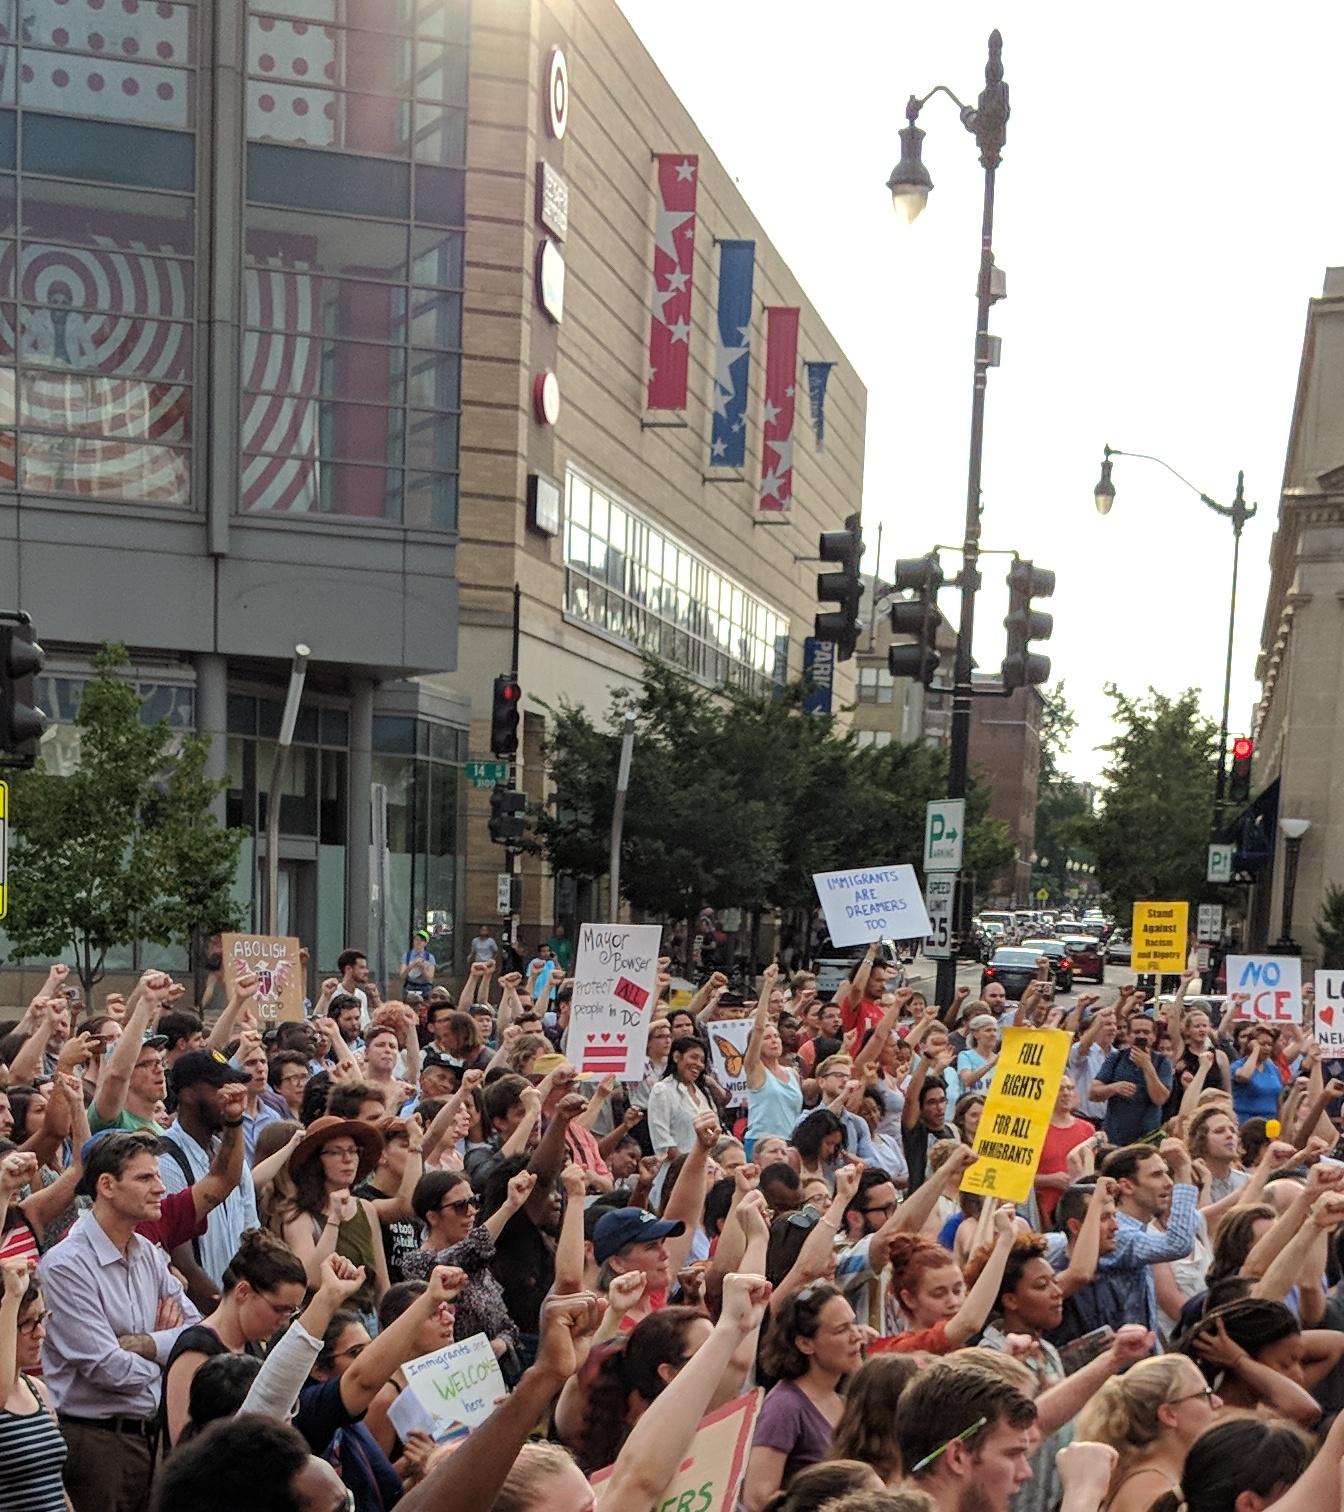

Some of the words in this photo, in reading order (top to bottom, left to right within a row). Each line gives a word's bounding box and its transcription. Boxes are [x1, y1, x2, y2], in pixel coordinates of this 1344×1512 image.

[473, 764, 485, 777] 14
[827, 871, 898, 890] IMMIGRANTS
[929, 881, 951, 895] SPEED
[855, 888, 878, 903] ARE
[846, 899, 907, 919] DREAMERS
[1147, 909, 1174, 918] Stand
[864, 918, 887, 931] TOO
[925, 917, 948, 948] 25
[1142, 923, 1177, 935] Against
[234, 940, 287, 958] ABOLISH
[584, 928, 630, 964] Mayor
[1145, 938, 1173, 947] Racism
[612, 952, 652, 973] Bowser
[1239, 961, 1280, 987] NO
[258, 1003, 277, 1018] ICE
[574, 1004, 604, 1023] people
[608, 1004, 617, 1017] in
[621, 1009, 641, 1027] DC
[1231, 991, 1292, 1021] ICE
[1017, 1042, 1045, 1067] FULL
[1001, 1073, 1044, 1101] RIGHTS
[992, 1113, 1012, 1136] FOR
[1011, 1116, 1032, 1139] ALL
[977, 1139, 1034, 1167] IMMIGRANTS
[408, 1344, 471, 1377] Immigrants
[472, 1341, 488, 1351] are
[432, 1356, 499, 1400] WELCOME
[461, 1398, 485, 1413] here
